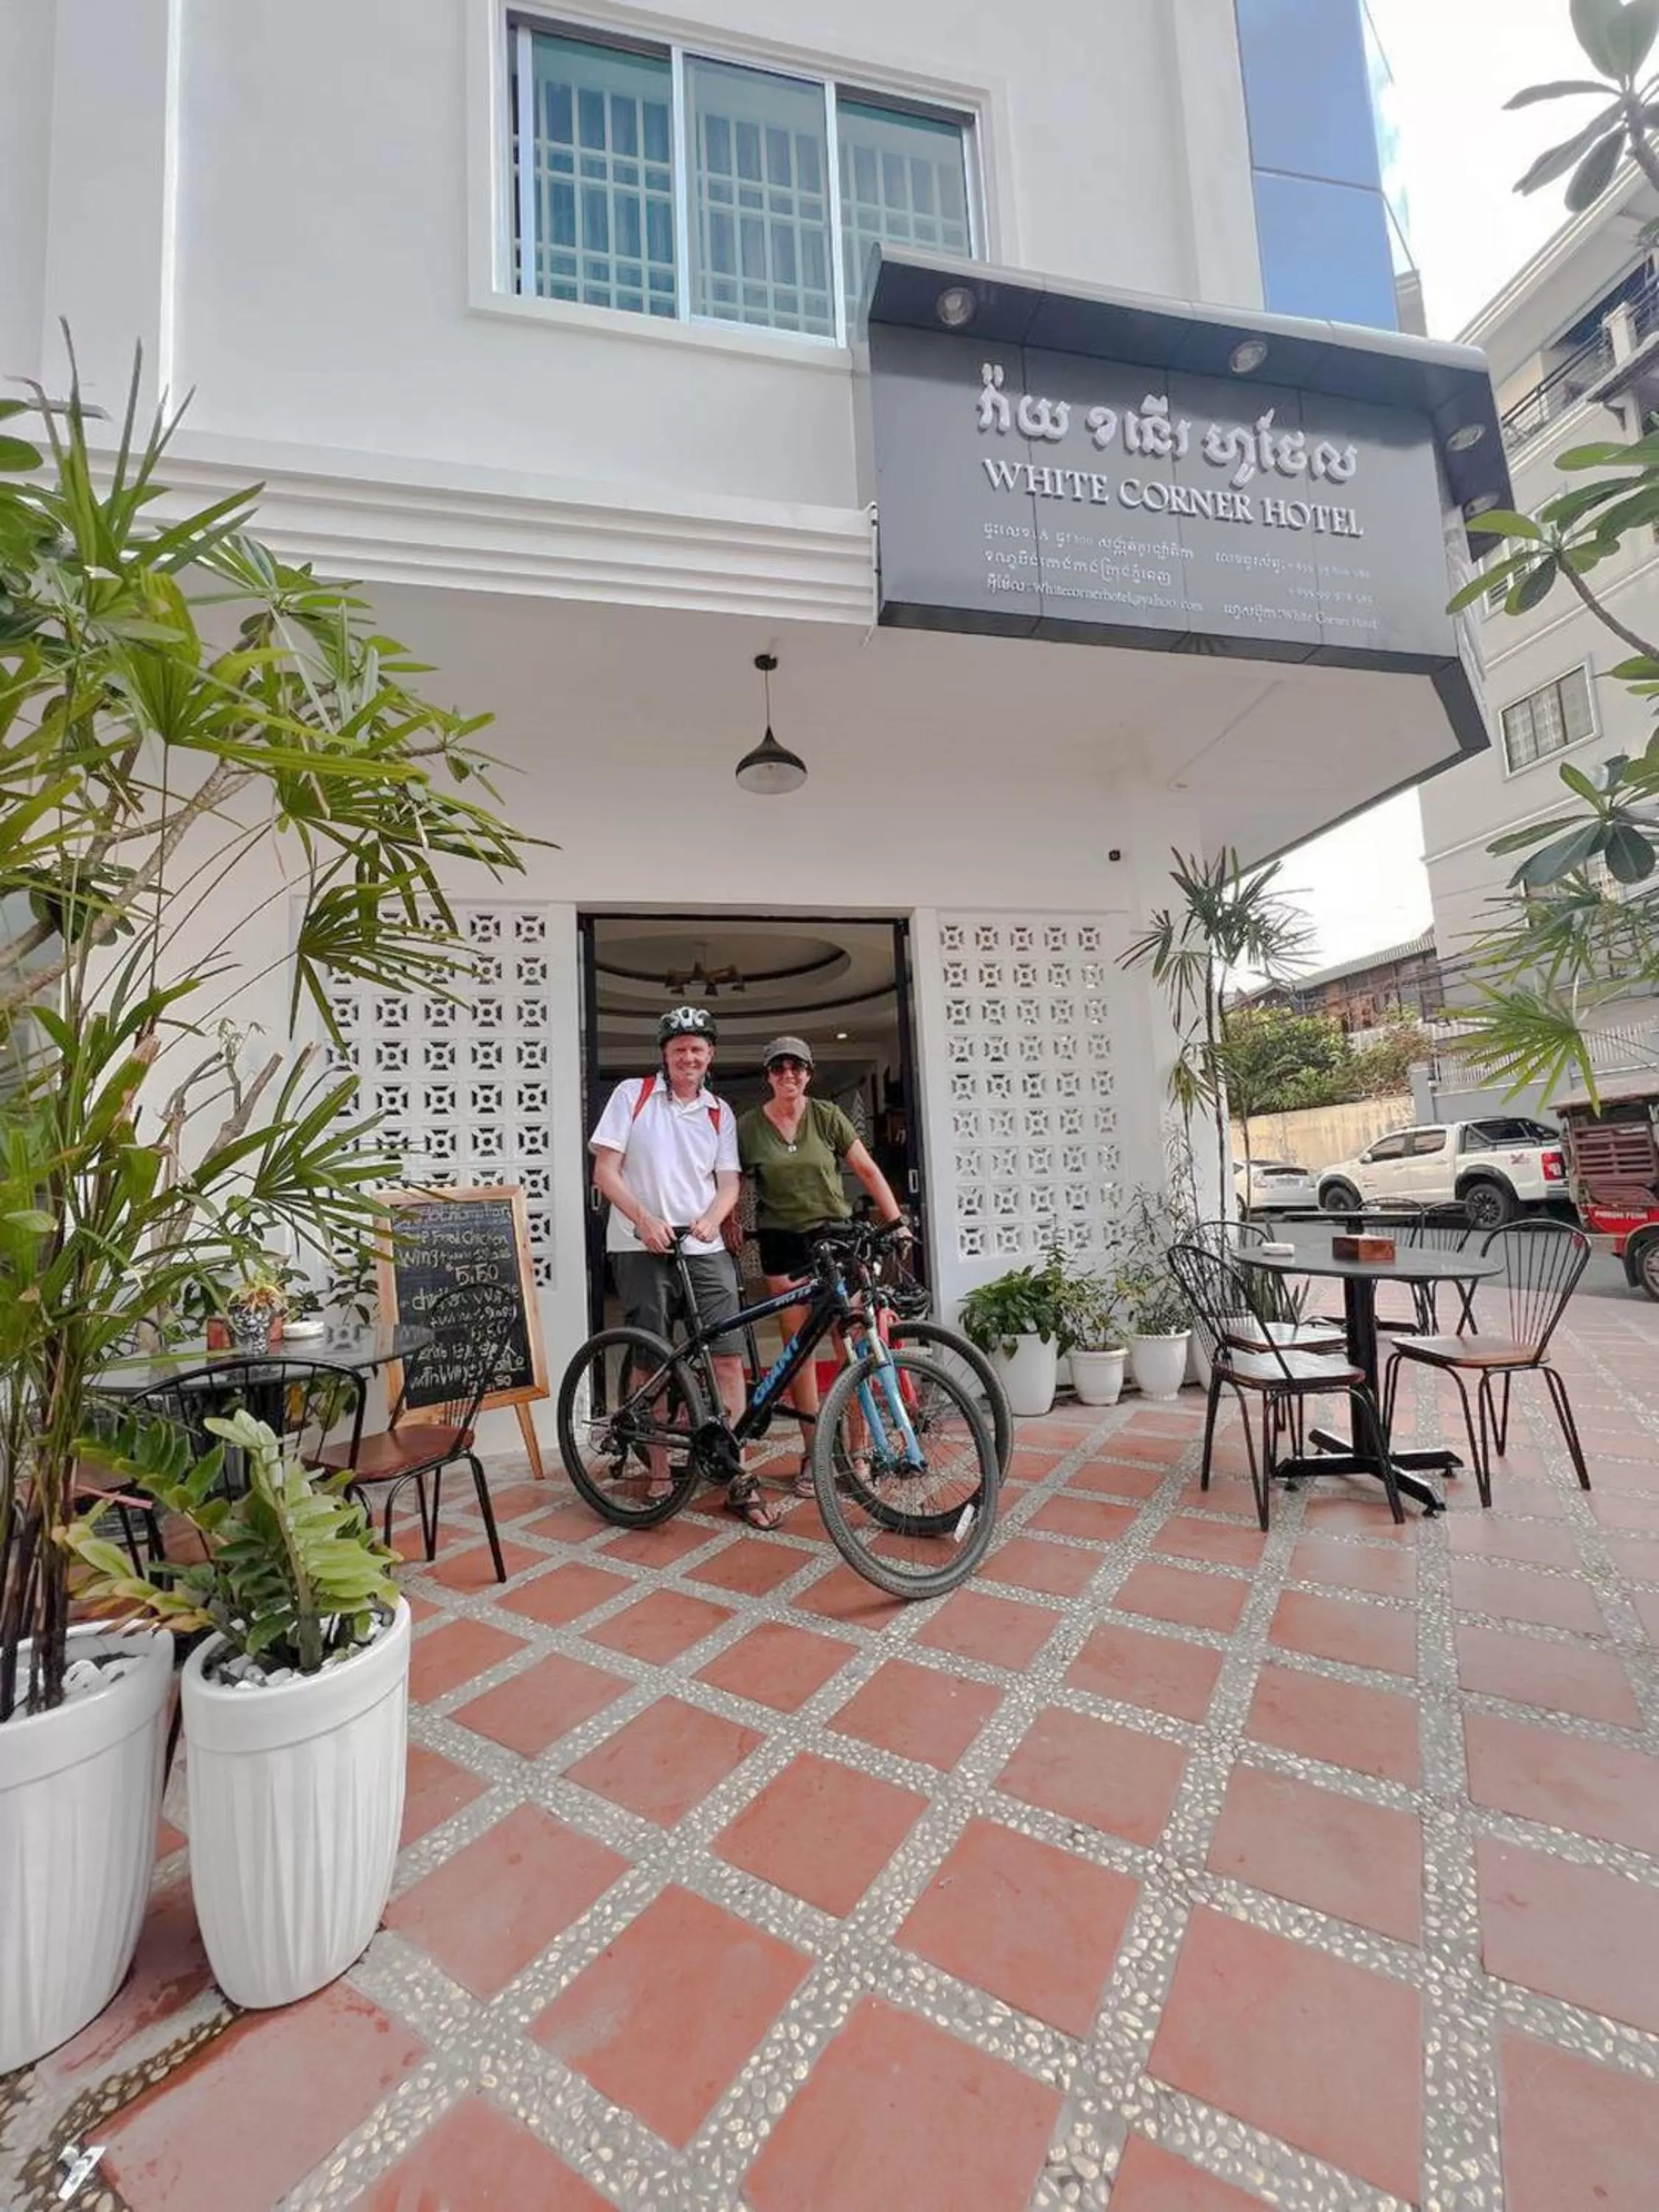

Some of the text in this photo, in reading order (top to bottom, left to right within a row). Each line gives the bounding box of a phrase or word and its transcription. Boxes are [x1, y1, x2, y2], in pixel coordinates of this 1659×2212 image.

[982, 457, 1363, 538] WHITE CORNER HOTEL
[752, 1334, 799, 1405] GIANT
